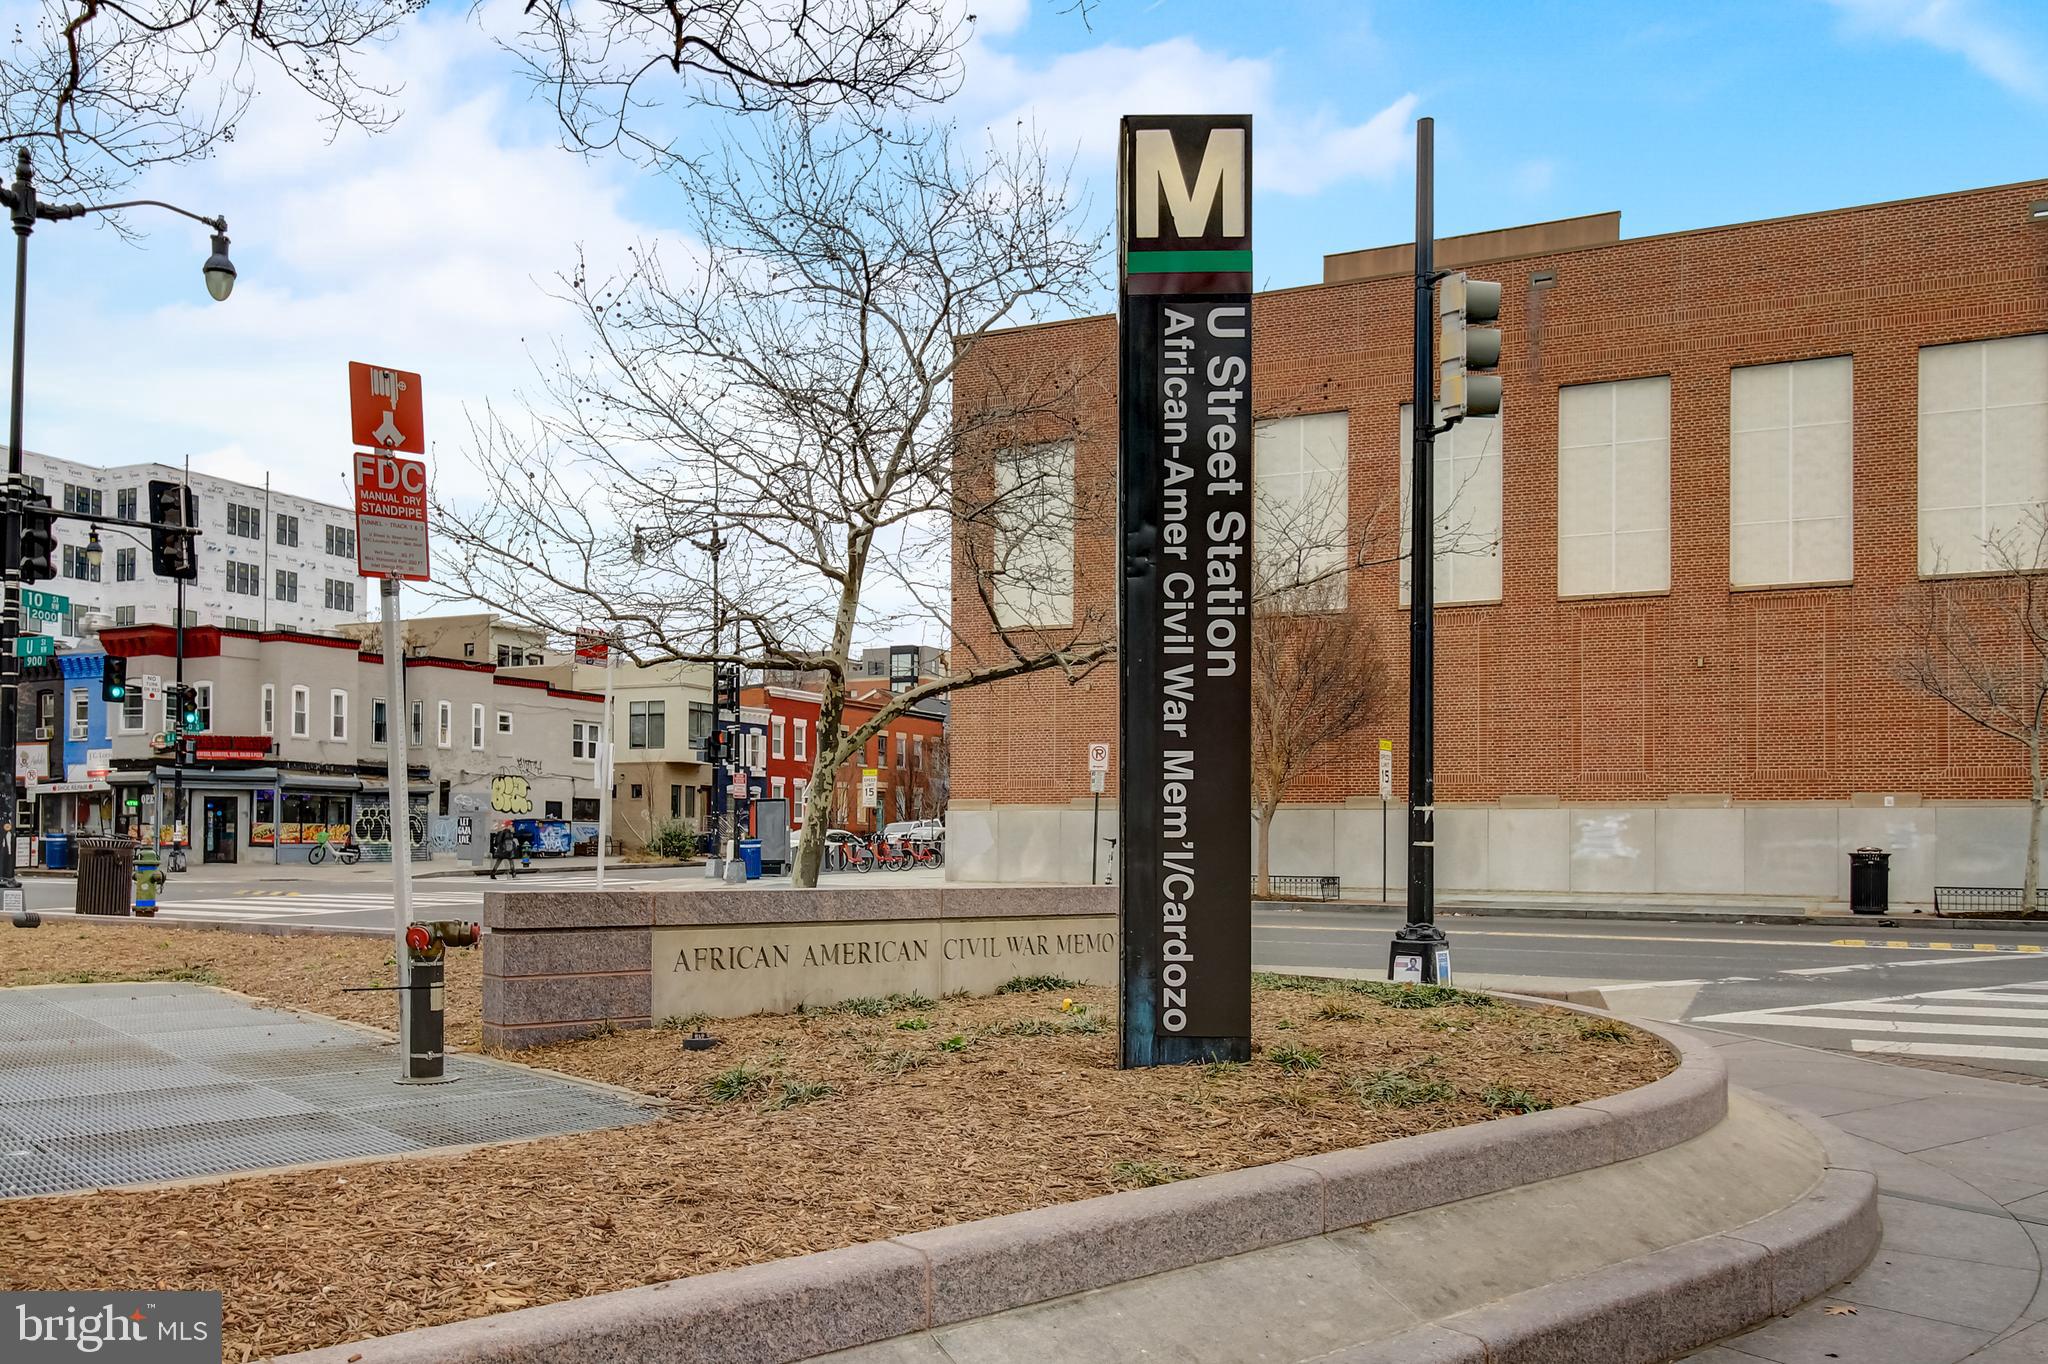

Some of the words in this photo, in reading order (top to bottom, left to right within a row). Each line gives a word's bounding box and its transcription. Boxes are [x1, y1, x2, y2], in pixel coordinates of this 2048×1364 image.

[1135, 128, 1245, 239] M
[1207, 307, 1246, 339] U
[1207, 355, 1246, 496] Street
[1162, 307, 1195, 561] African-Amer
[356, 455, 424, 494] FDC
[360, 490, 400, 504] MANUAL
[402, 495, 422, 506] DRY
[361, 502, 423, 519] STANDPIPE
[27, 591, 43, 607] 10
[1207, 511, 1246, 677] Station
[31, 609, 57, 621] 2000
[1162, 573, 1196, 654] Civil
[26, 639, 33, 654] U
[26, 656, 42, 666] 900
[1162, 664, 1195, 739] War
[1381, 769, 1390, 784] 15
[864, 787, 874, 797] 15
[459, 816, 469, 826] LET
[458, 826, 472, 835] GAZA
[458, 835, 471, 844] LIVE
[672, 944, 790, 973] AFRICAN
[802, 939, 929, 968] AMERICAN
[943, 936, 1002, 961] CIVIL
[1006, 934, 1050, 957] WAR
